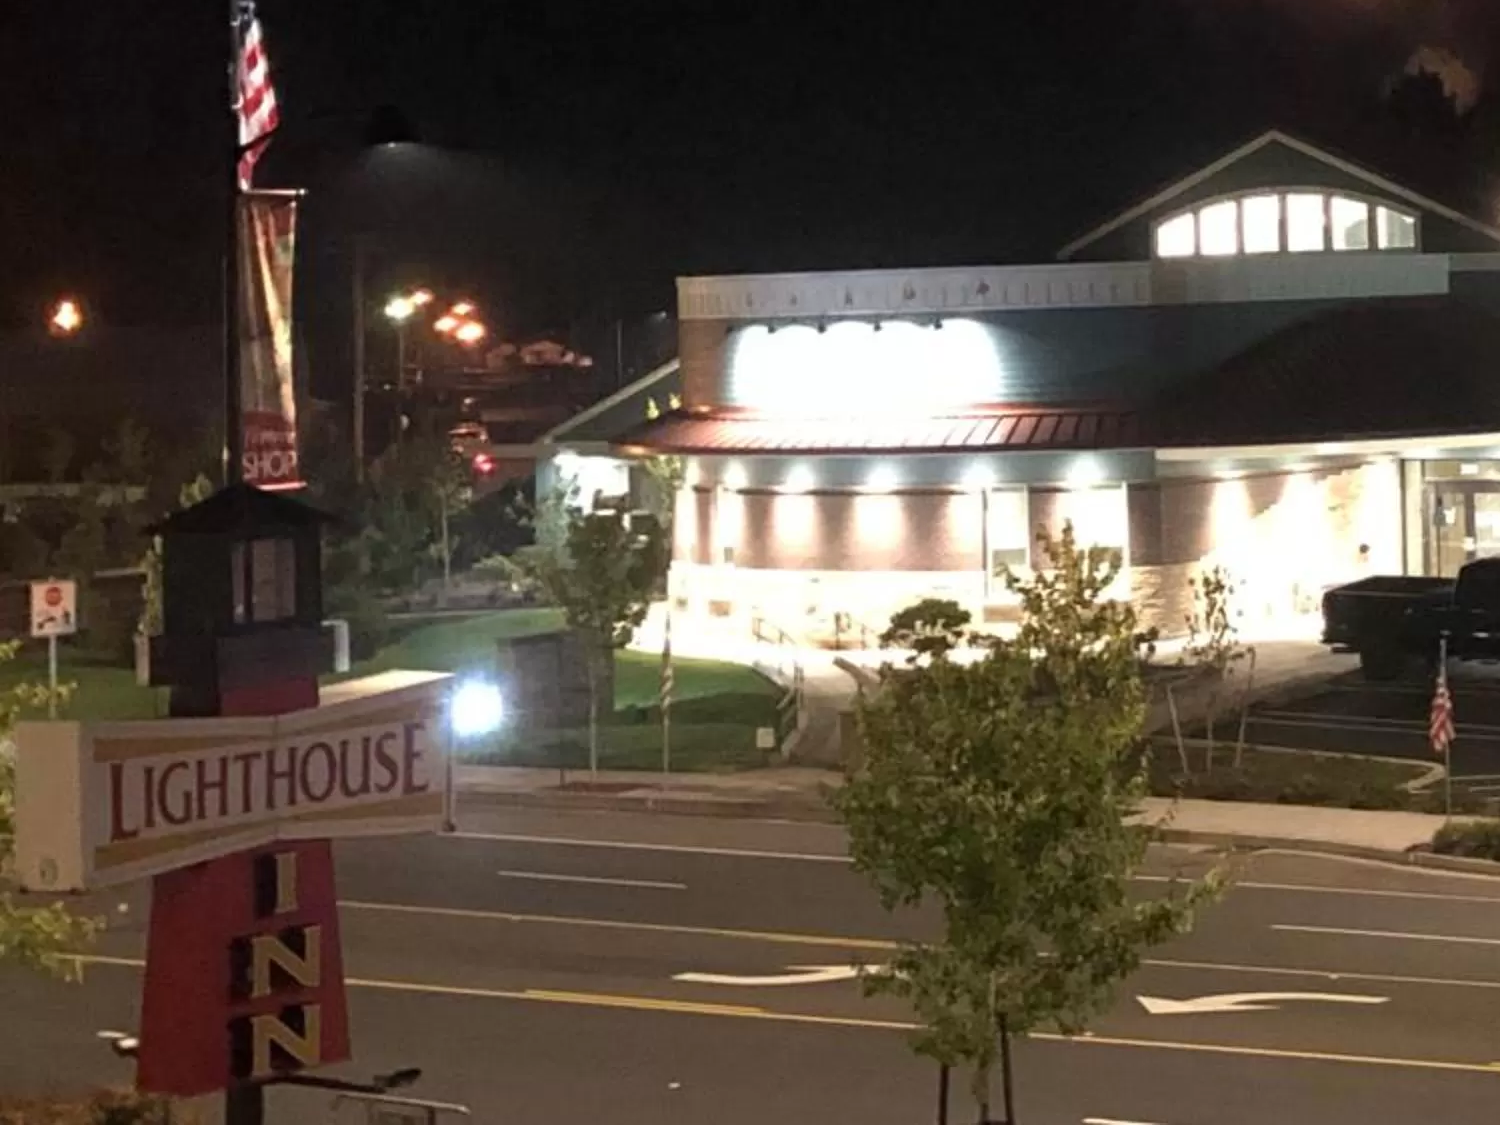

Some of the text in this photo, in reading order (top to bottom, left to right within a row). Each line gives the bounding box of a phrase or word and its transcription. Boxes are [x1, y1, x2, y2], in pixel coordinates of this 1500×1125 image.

[241, 450, 297, 481] SHOP
[110, 722, 429, 841] LIGHTHOUSE
[250, 850, 322, 1078] INN
